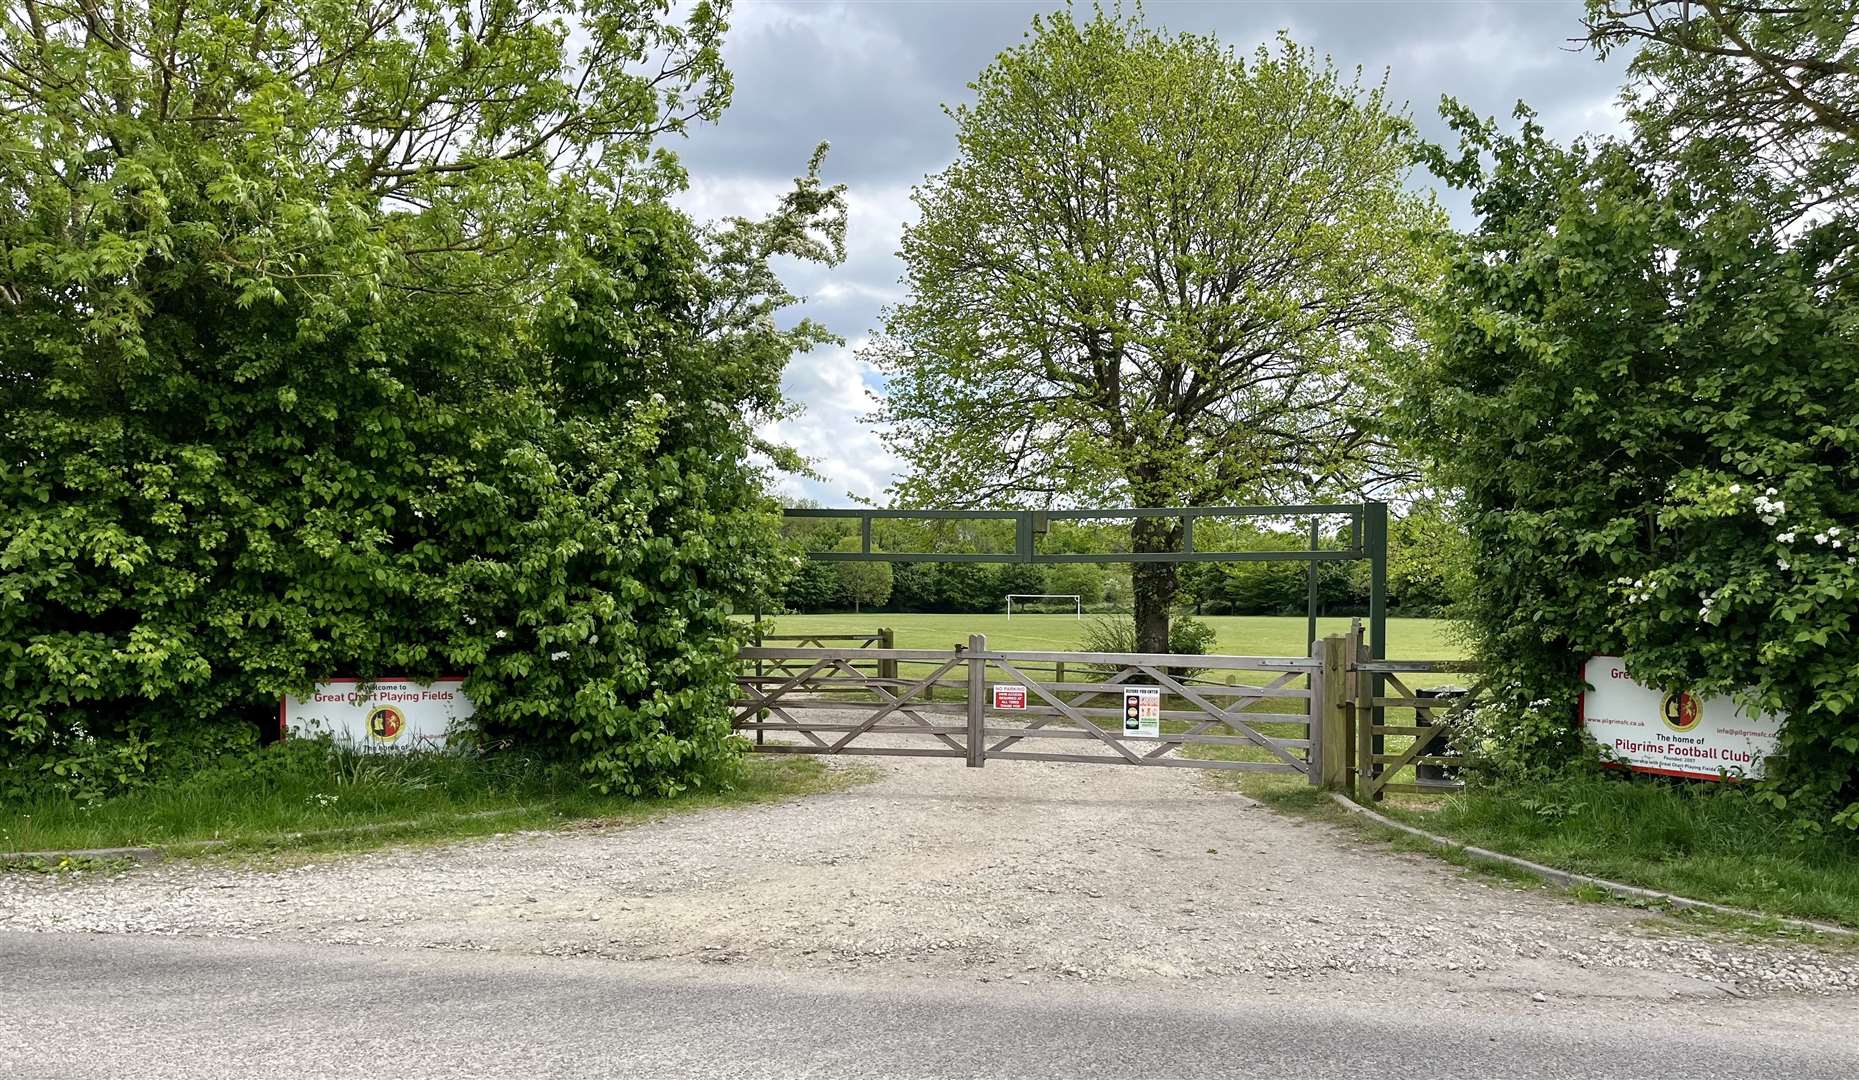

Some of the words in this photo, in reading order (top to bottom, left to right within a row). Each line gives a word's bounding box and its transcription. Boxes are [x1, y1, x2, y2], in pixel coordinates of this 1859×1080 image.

[1611, 668, 1633, 679] Gre
[314, 693, 345, 702] Great
[347, 692, 377, 702] Chrt
[380, 692, 419, 702] Playing
[422, 691, 454, 700] Fields
[1656, 734, 1671, 742] The
[1672, 735, 1695, 744] home
[1696, 737, 1705, 745] of
[1615, 739, 1664, 753] Pilgrims
[1667, 744, 1717, 759] Football
[1721, 749, 1750, 763] Club
